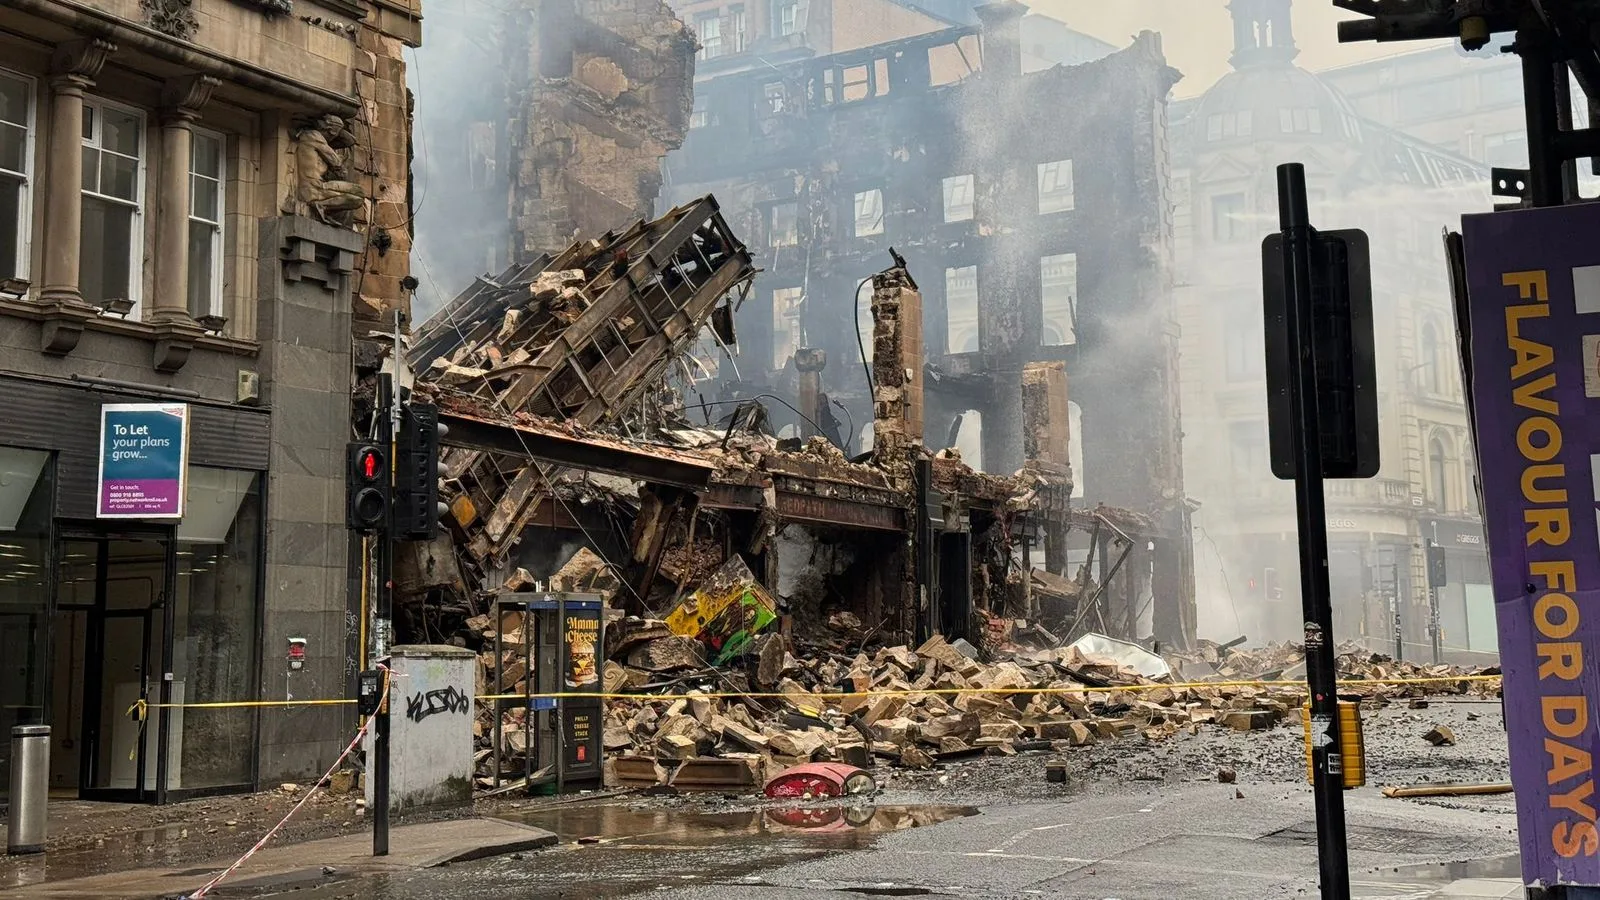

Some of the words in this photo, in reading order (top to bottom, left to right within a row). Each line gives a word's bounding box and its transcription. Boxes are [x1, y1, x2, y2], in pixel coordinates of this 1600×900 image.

[113, 424, 127, 435] To
[130, 424, 148, 435] Let
[1501, 269, 1571, 547] FLAVOUR
[112, 439, 138, 450] your
[140, 436, 170, 449] plans
[112, 450, 147, 461] grow...
[1529, 560, 1584, 681] FOR
[1541, 695, 1599, 859] DAYS
